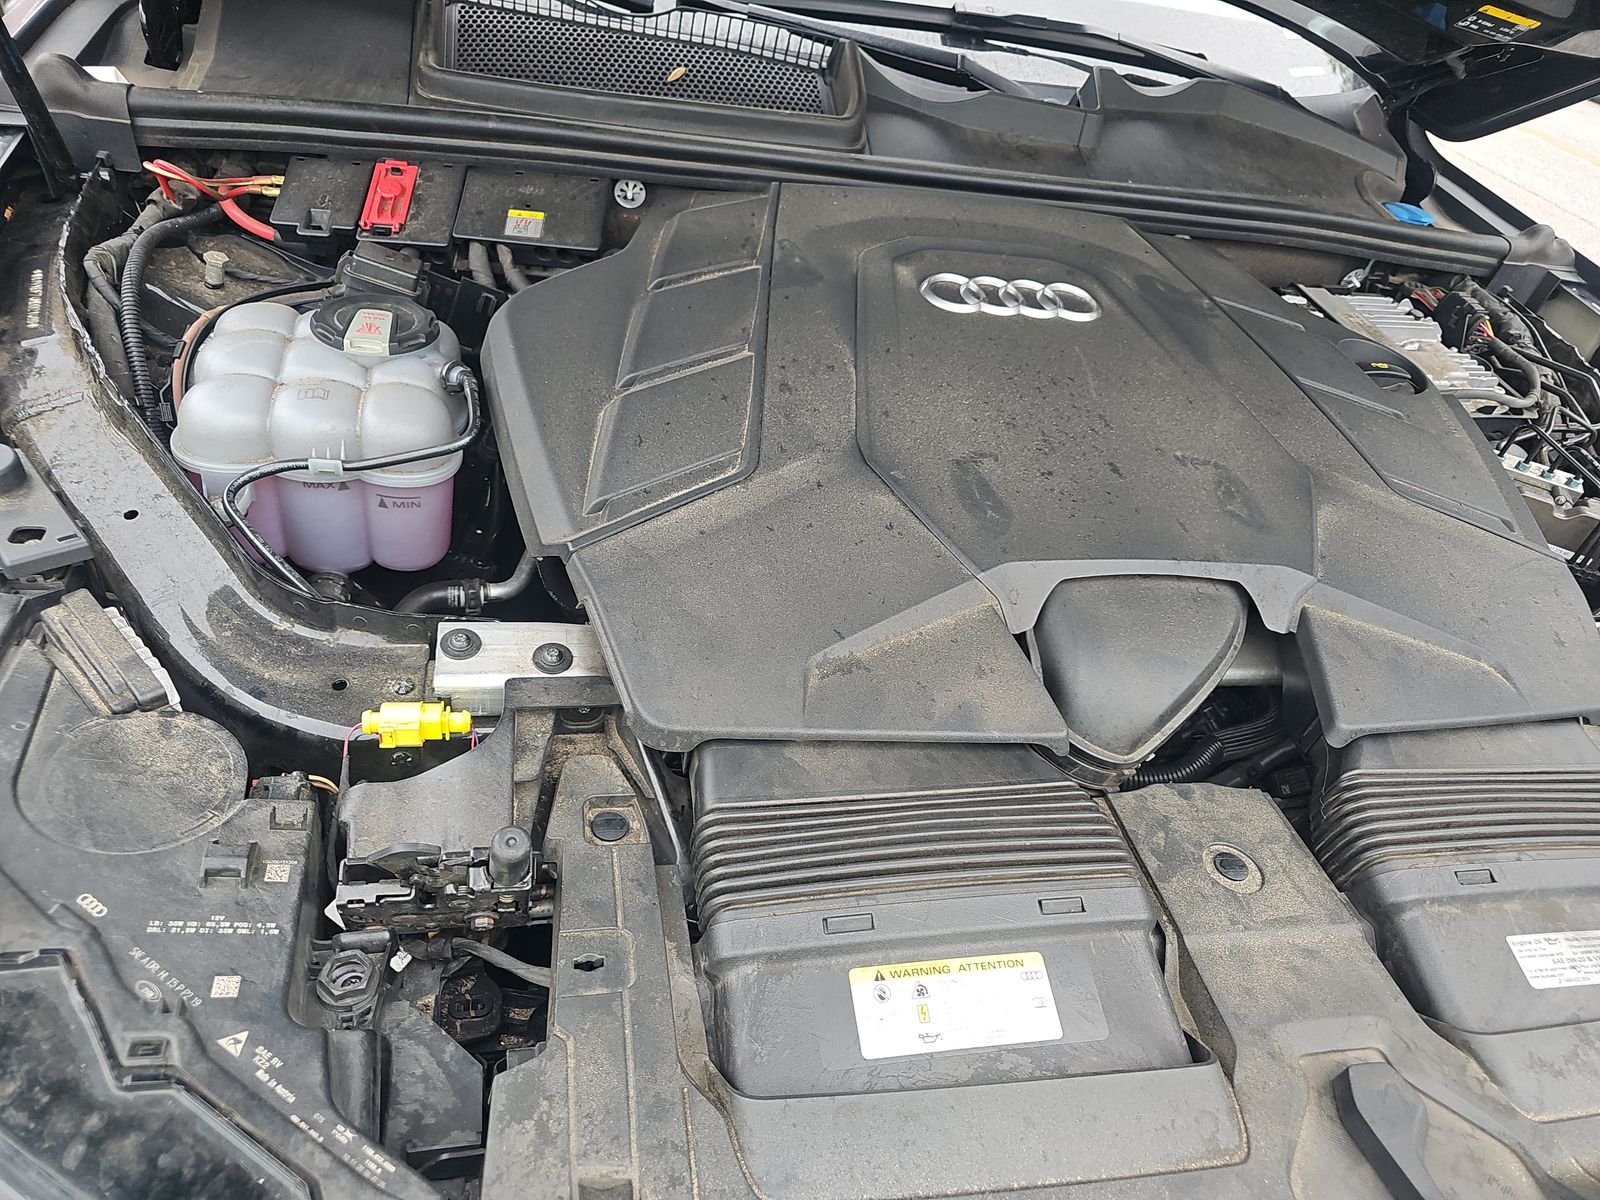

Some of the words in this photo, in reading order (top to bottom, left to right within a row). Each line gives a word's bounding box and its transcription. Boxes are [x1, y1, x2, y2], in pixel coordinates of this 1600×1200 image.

[392, 501, 421, 509] MIN
[889, 965, 951, 979] WARNING
[958, 959, 1025, 974] ATTENTION
